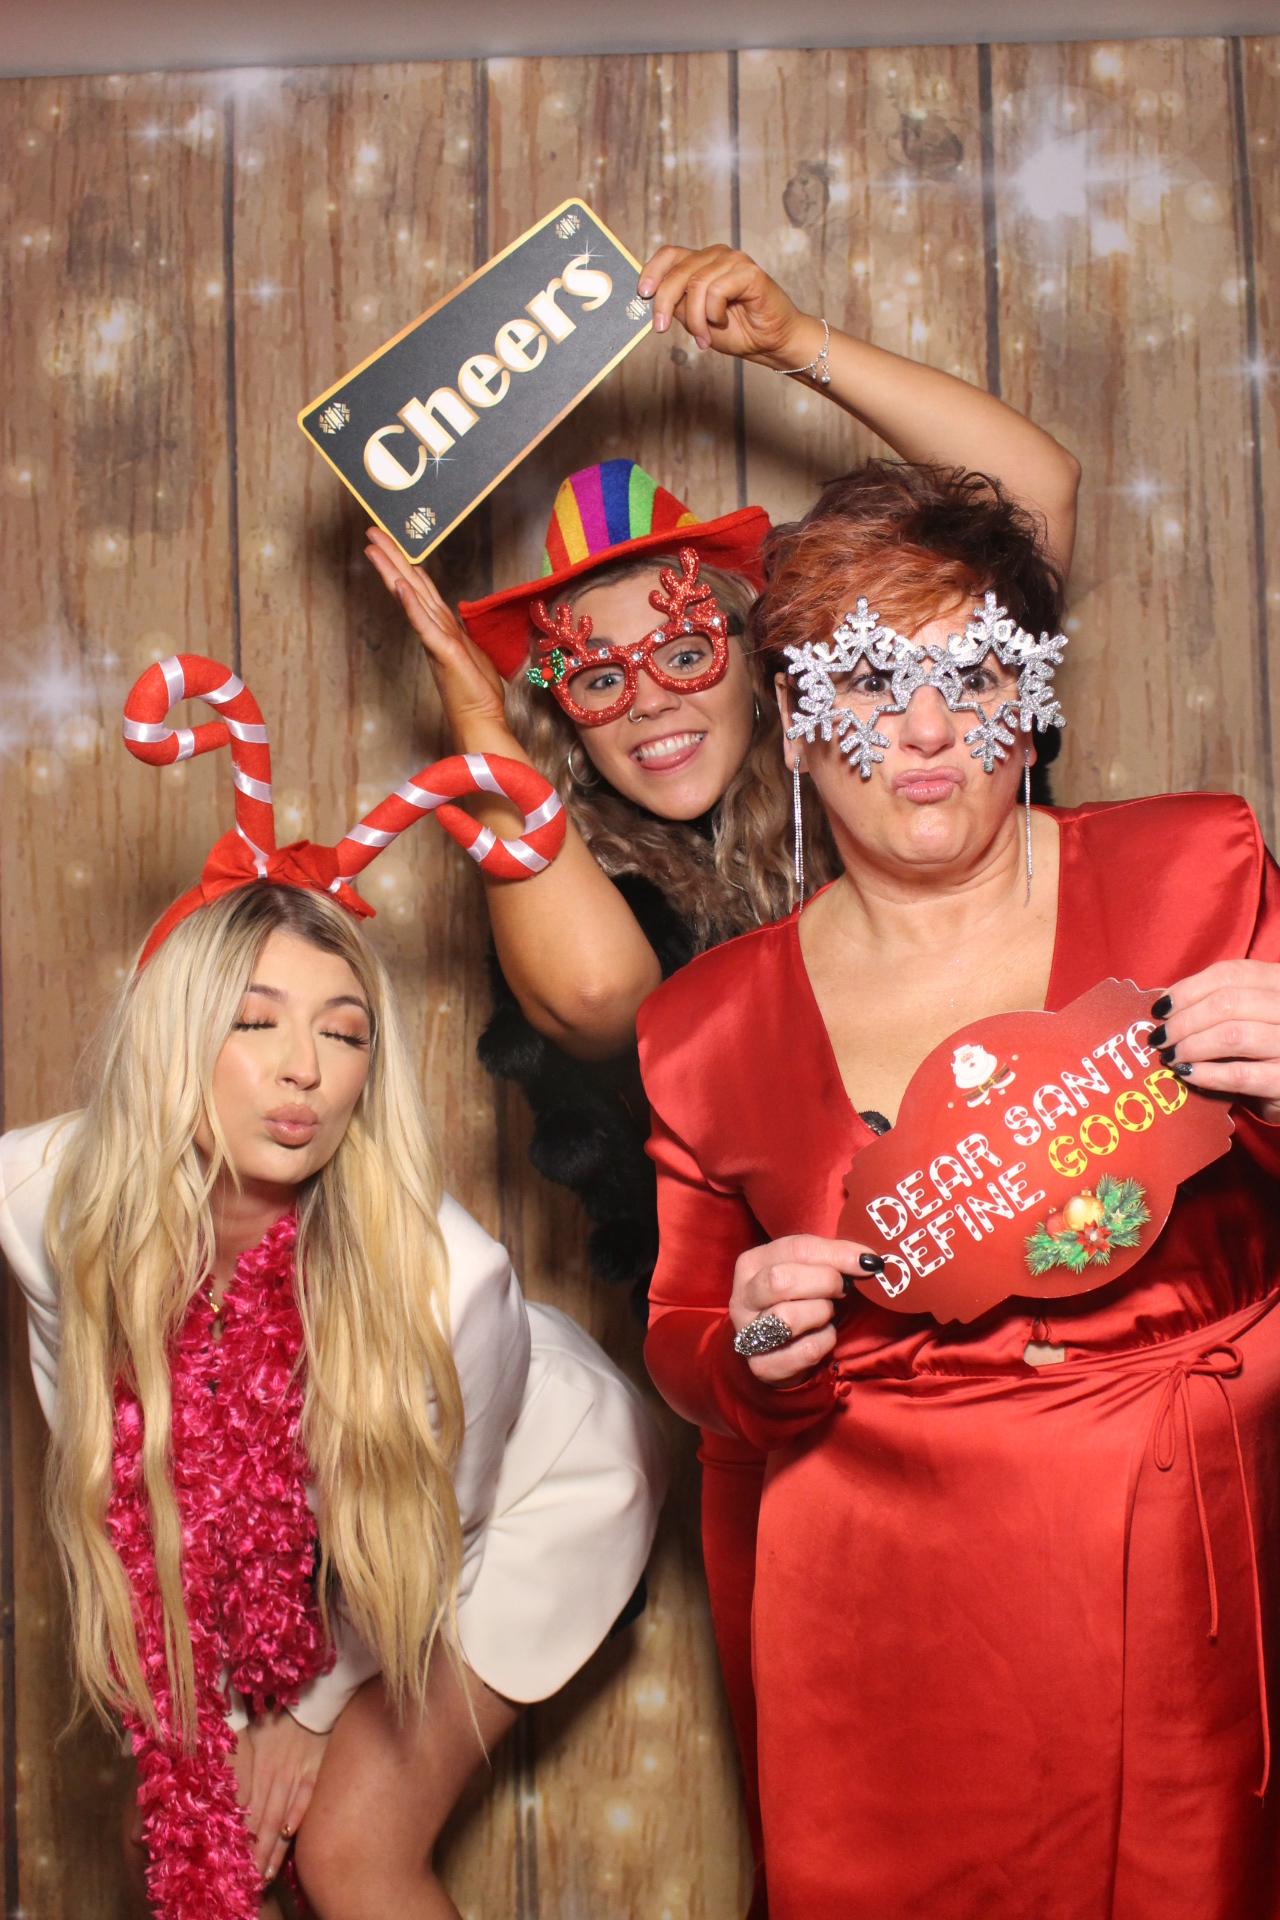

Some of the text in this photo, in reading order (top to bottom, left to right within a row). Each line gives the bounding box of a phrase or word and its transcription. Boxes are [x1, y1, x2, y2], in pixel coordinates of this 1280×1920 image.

[363, 254, 613, 491] Cheers
[866, 1133, 1002, 1240] DEAR
[874, 1068, 1189, 1297] DEFINE GOOD
